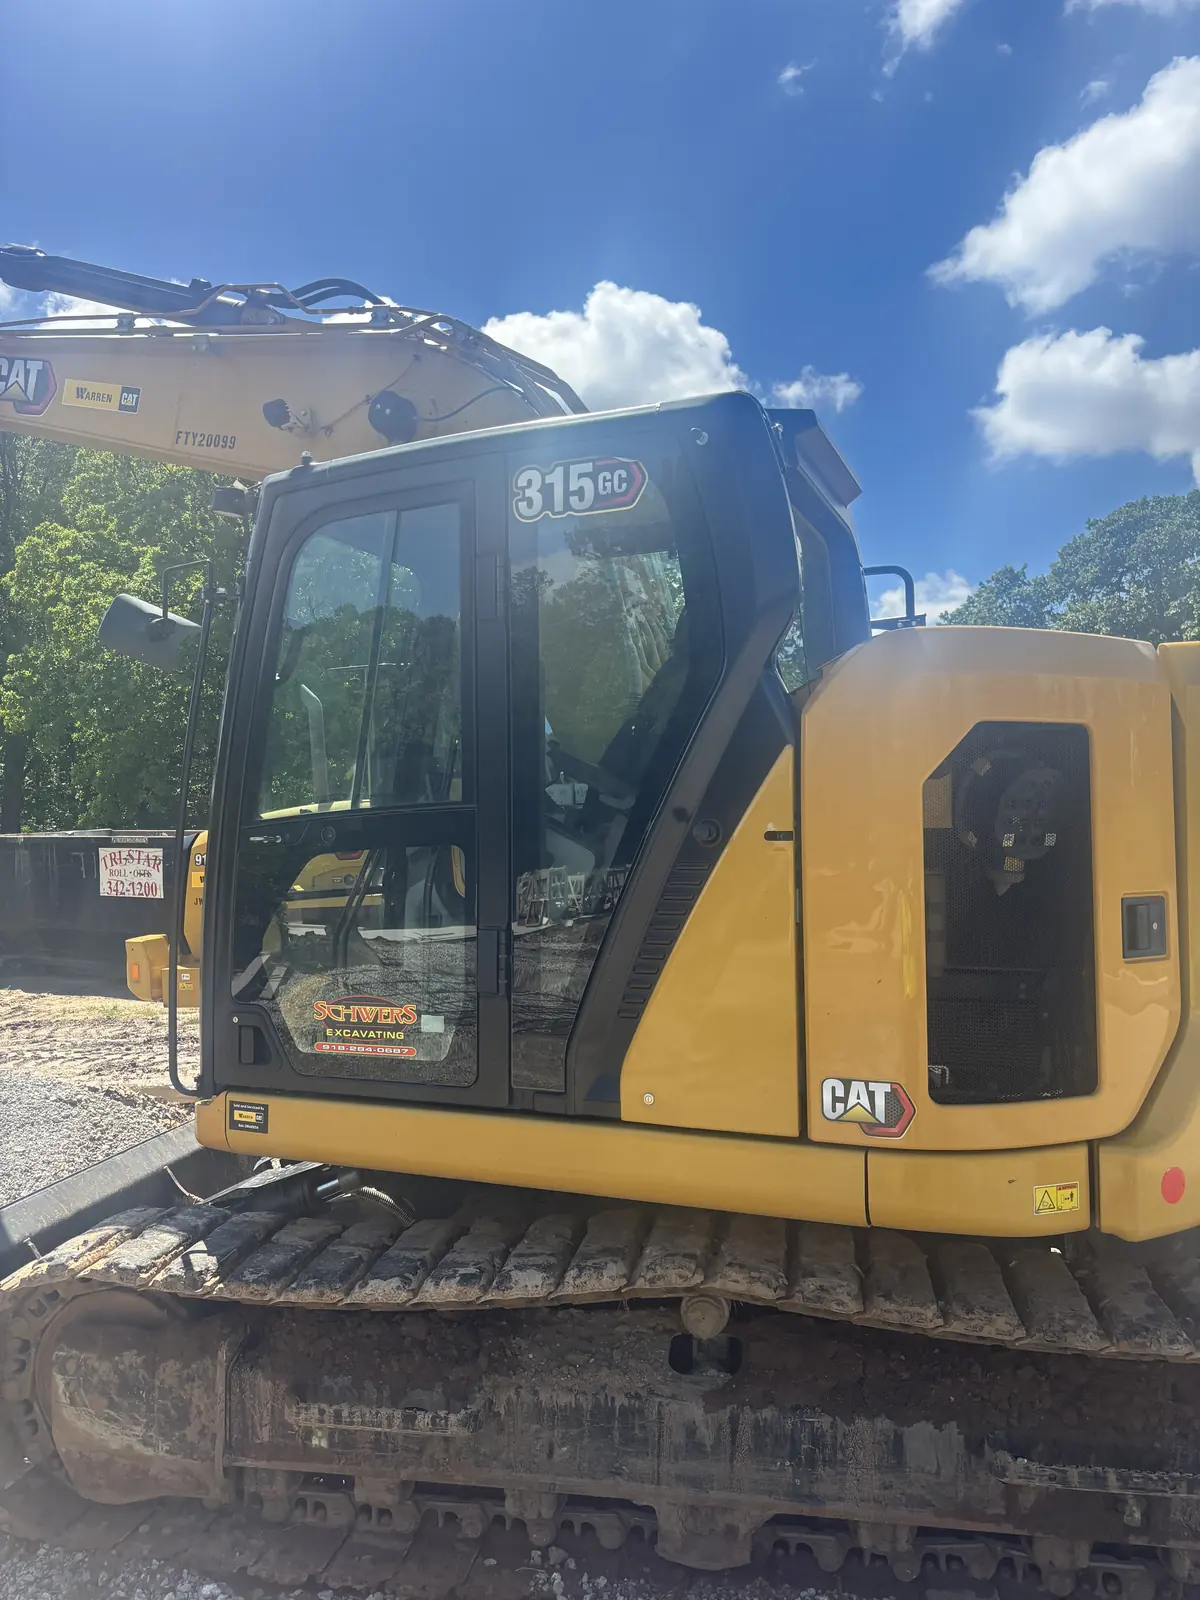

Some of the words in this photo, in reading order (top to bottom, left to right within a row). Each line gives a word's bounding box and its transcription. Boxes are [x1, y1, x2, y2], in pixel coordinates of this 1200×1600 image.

[76, 387, 113, 403] WARREN
[121, 393, 138, 406] CAT
[175, 431, 236, 450] FTY20099
[517, 462, 594, 517] 315
[598, 469, 627, 495] GC
[106, 881, 158, 898] 342-1200
[313, 1001, 417, 1025] SCHWERS
[326, 1028, 404, 1040] EXCAVATING
[822, 1078, 891, 1123] CAT
